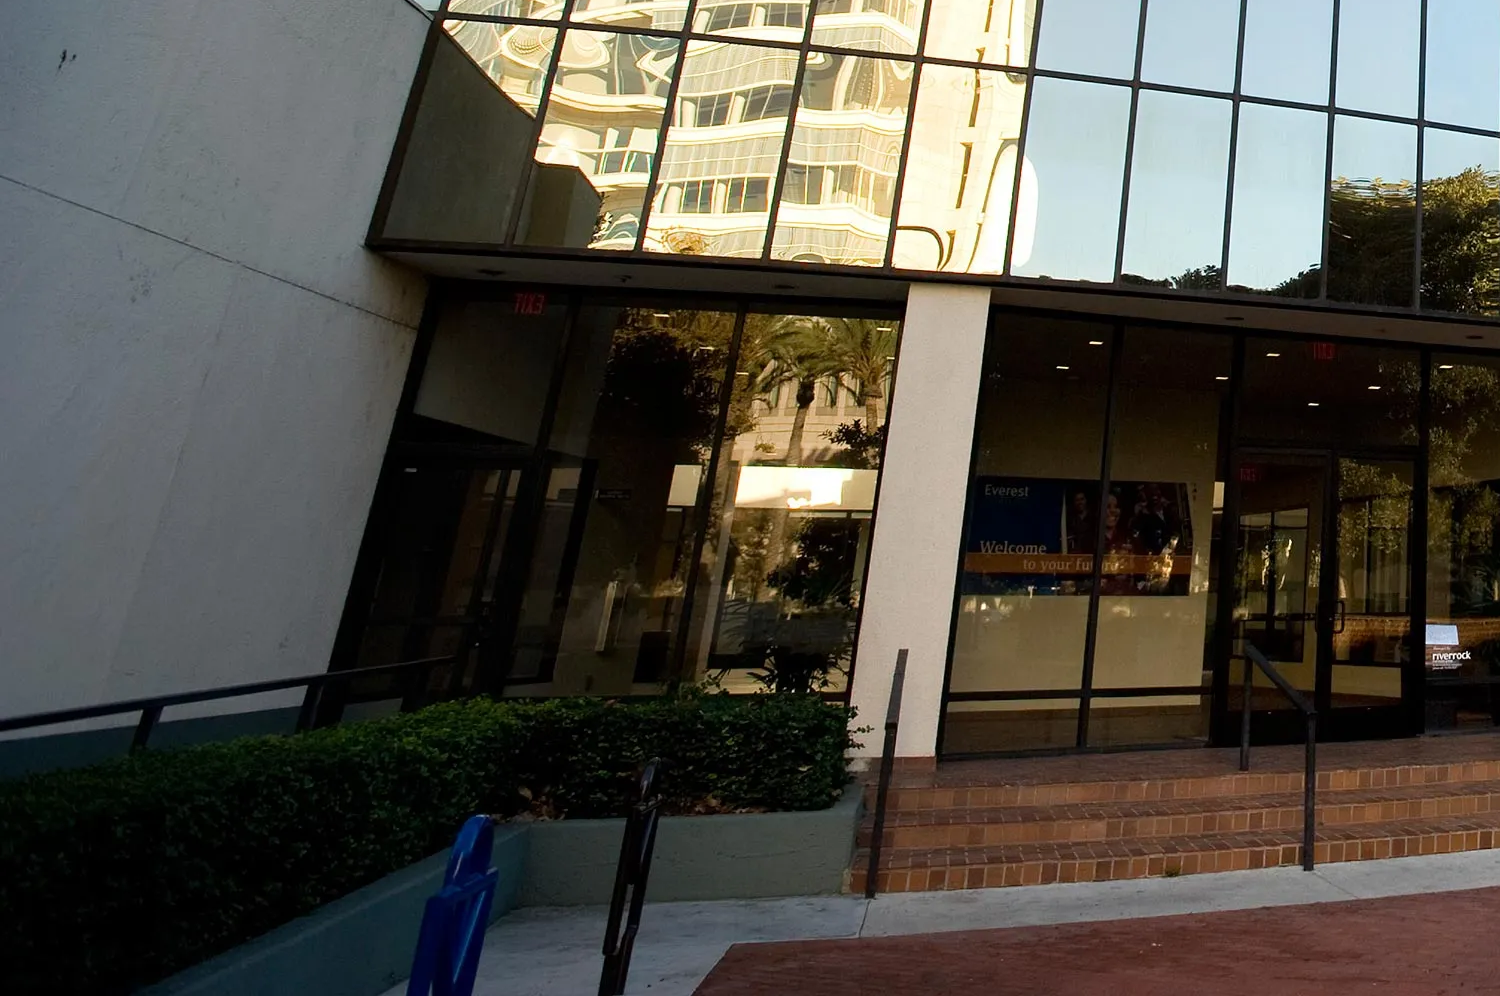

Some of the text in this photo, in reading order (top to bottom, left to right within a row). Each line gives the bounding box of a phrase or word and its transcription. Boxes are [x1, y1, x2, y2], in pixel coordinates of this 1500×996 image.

[984, 484, 1029, 497] Everest
[979, 540, 1048, 555] Welcome
[1023, 559, 1036, 571] to
[1040, 561, 1072, 575] your
[1432, 650, 1472, 660] riverrock
